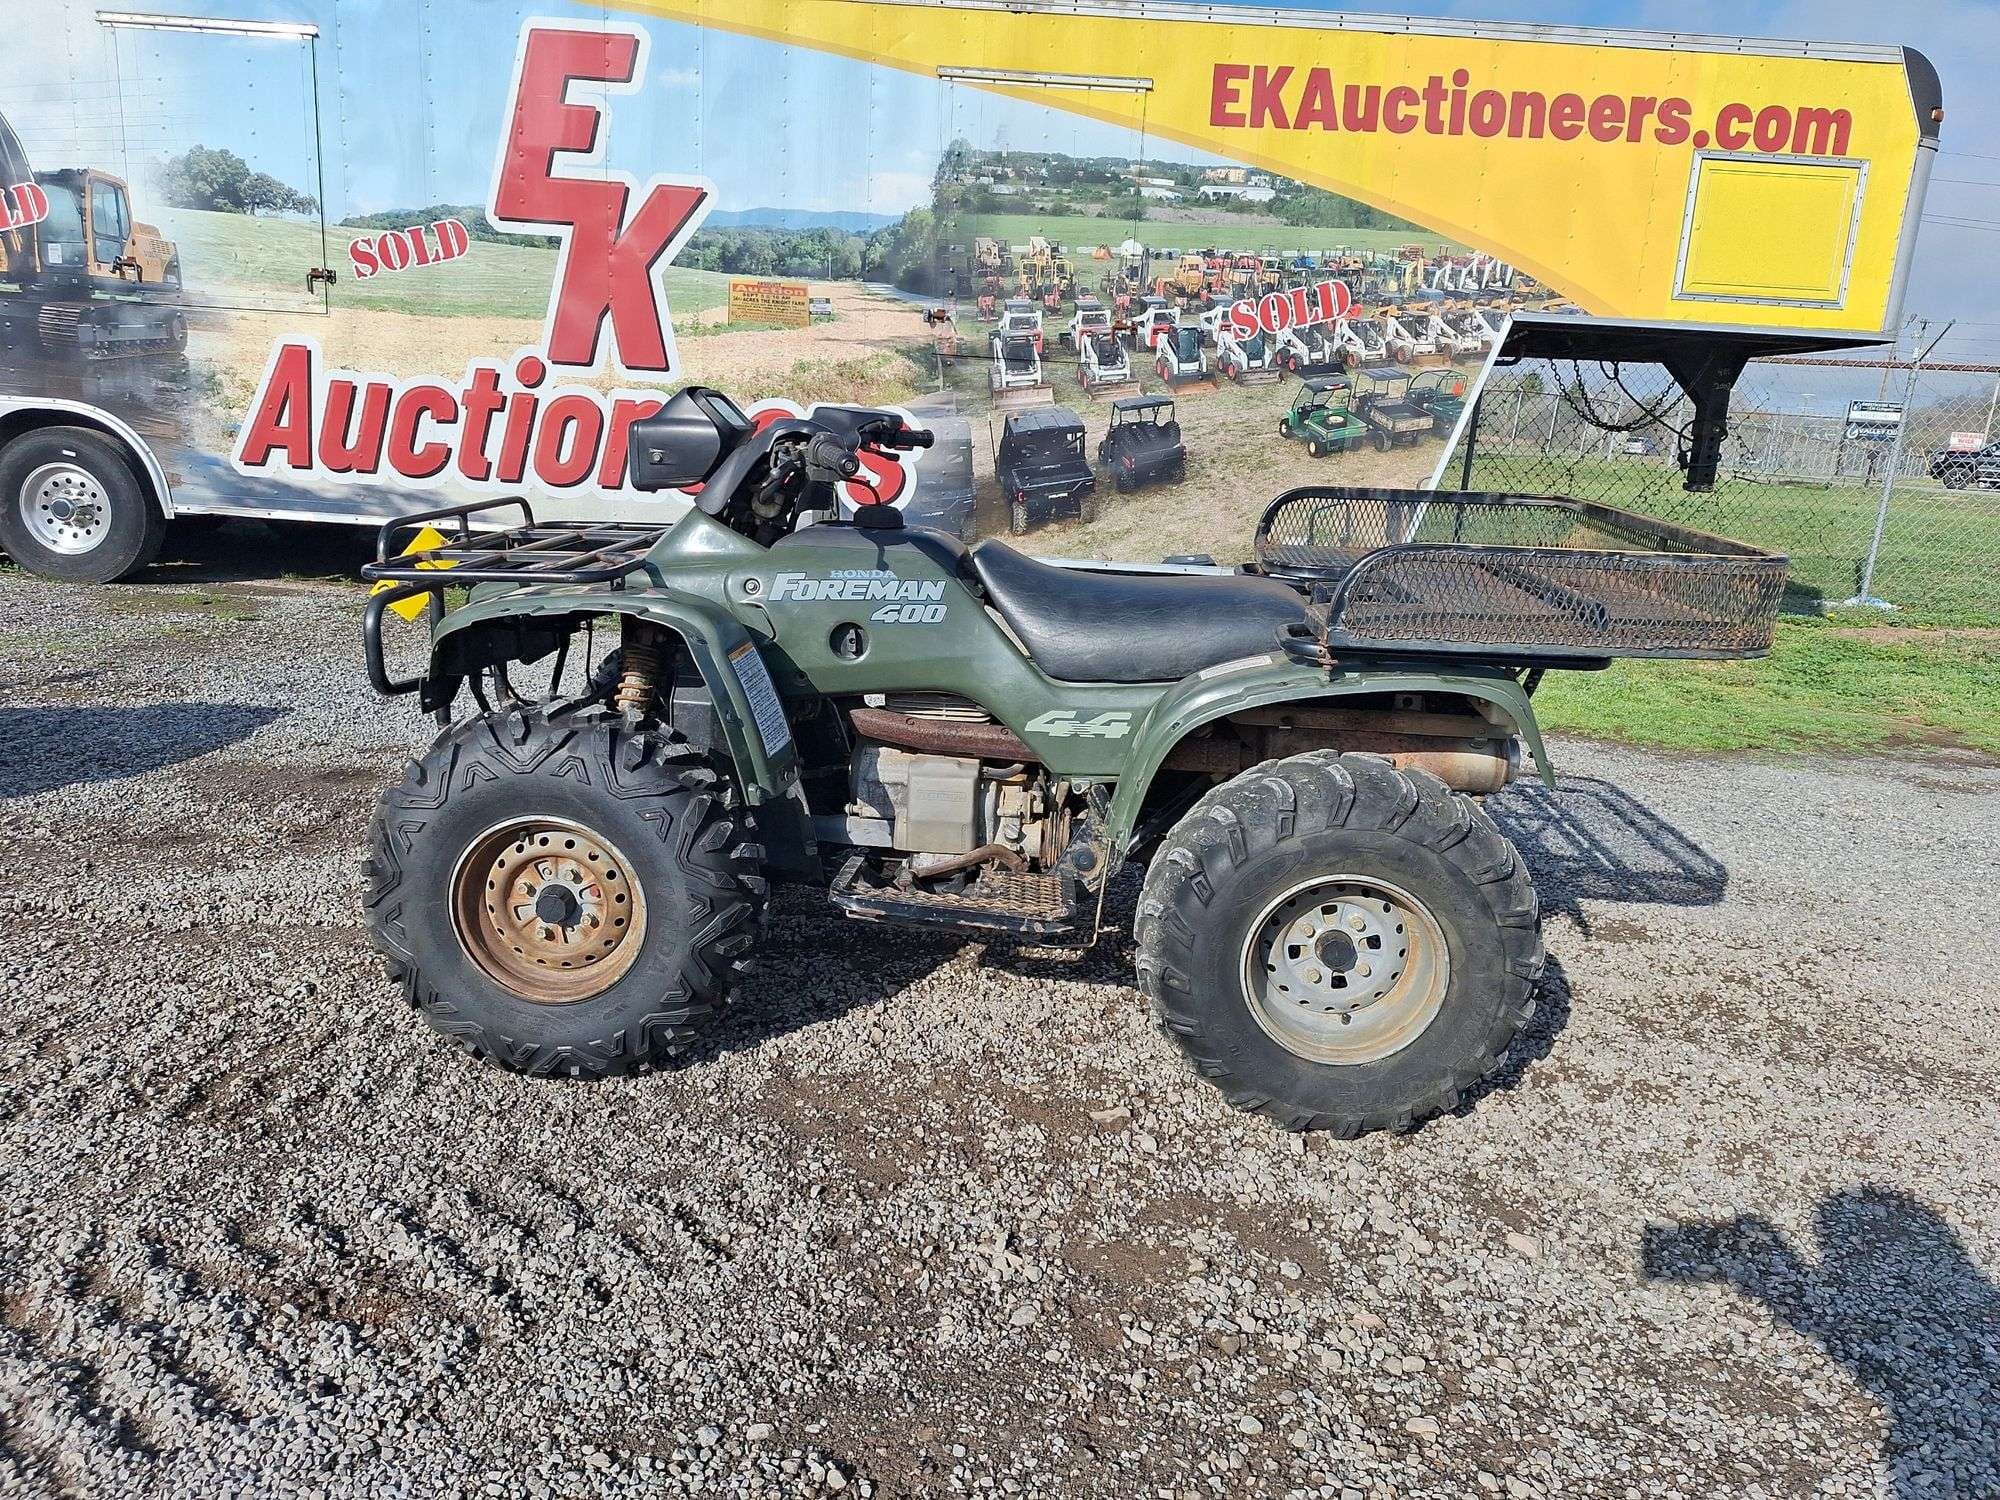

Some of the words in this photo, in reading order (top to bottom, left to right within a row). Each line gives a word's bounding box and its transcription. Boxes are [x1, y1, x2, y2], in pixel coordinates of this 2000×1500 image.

[1209, 62, 1853, 156] EKAuctioneers.com
[494, 28, 709, 372] EK
[348, 219, 469, 278] SOLD
[735, 284, 806, 297] Auction
[1229, 281, 1350, 340] SOLD
[769, 572, 948, 601] FOREMAN
[830, 569, 898, 579] HONDA
[870, 603, 949, 624] 400
